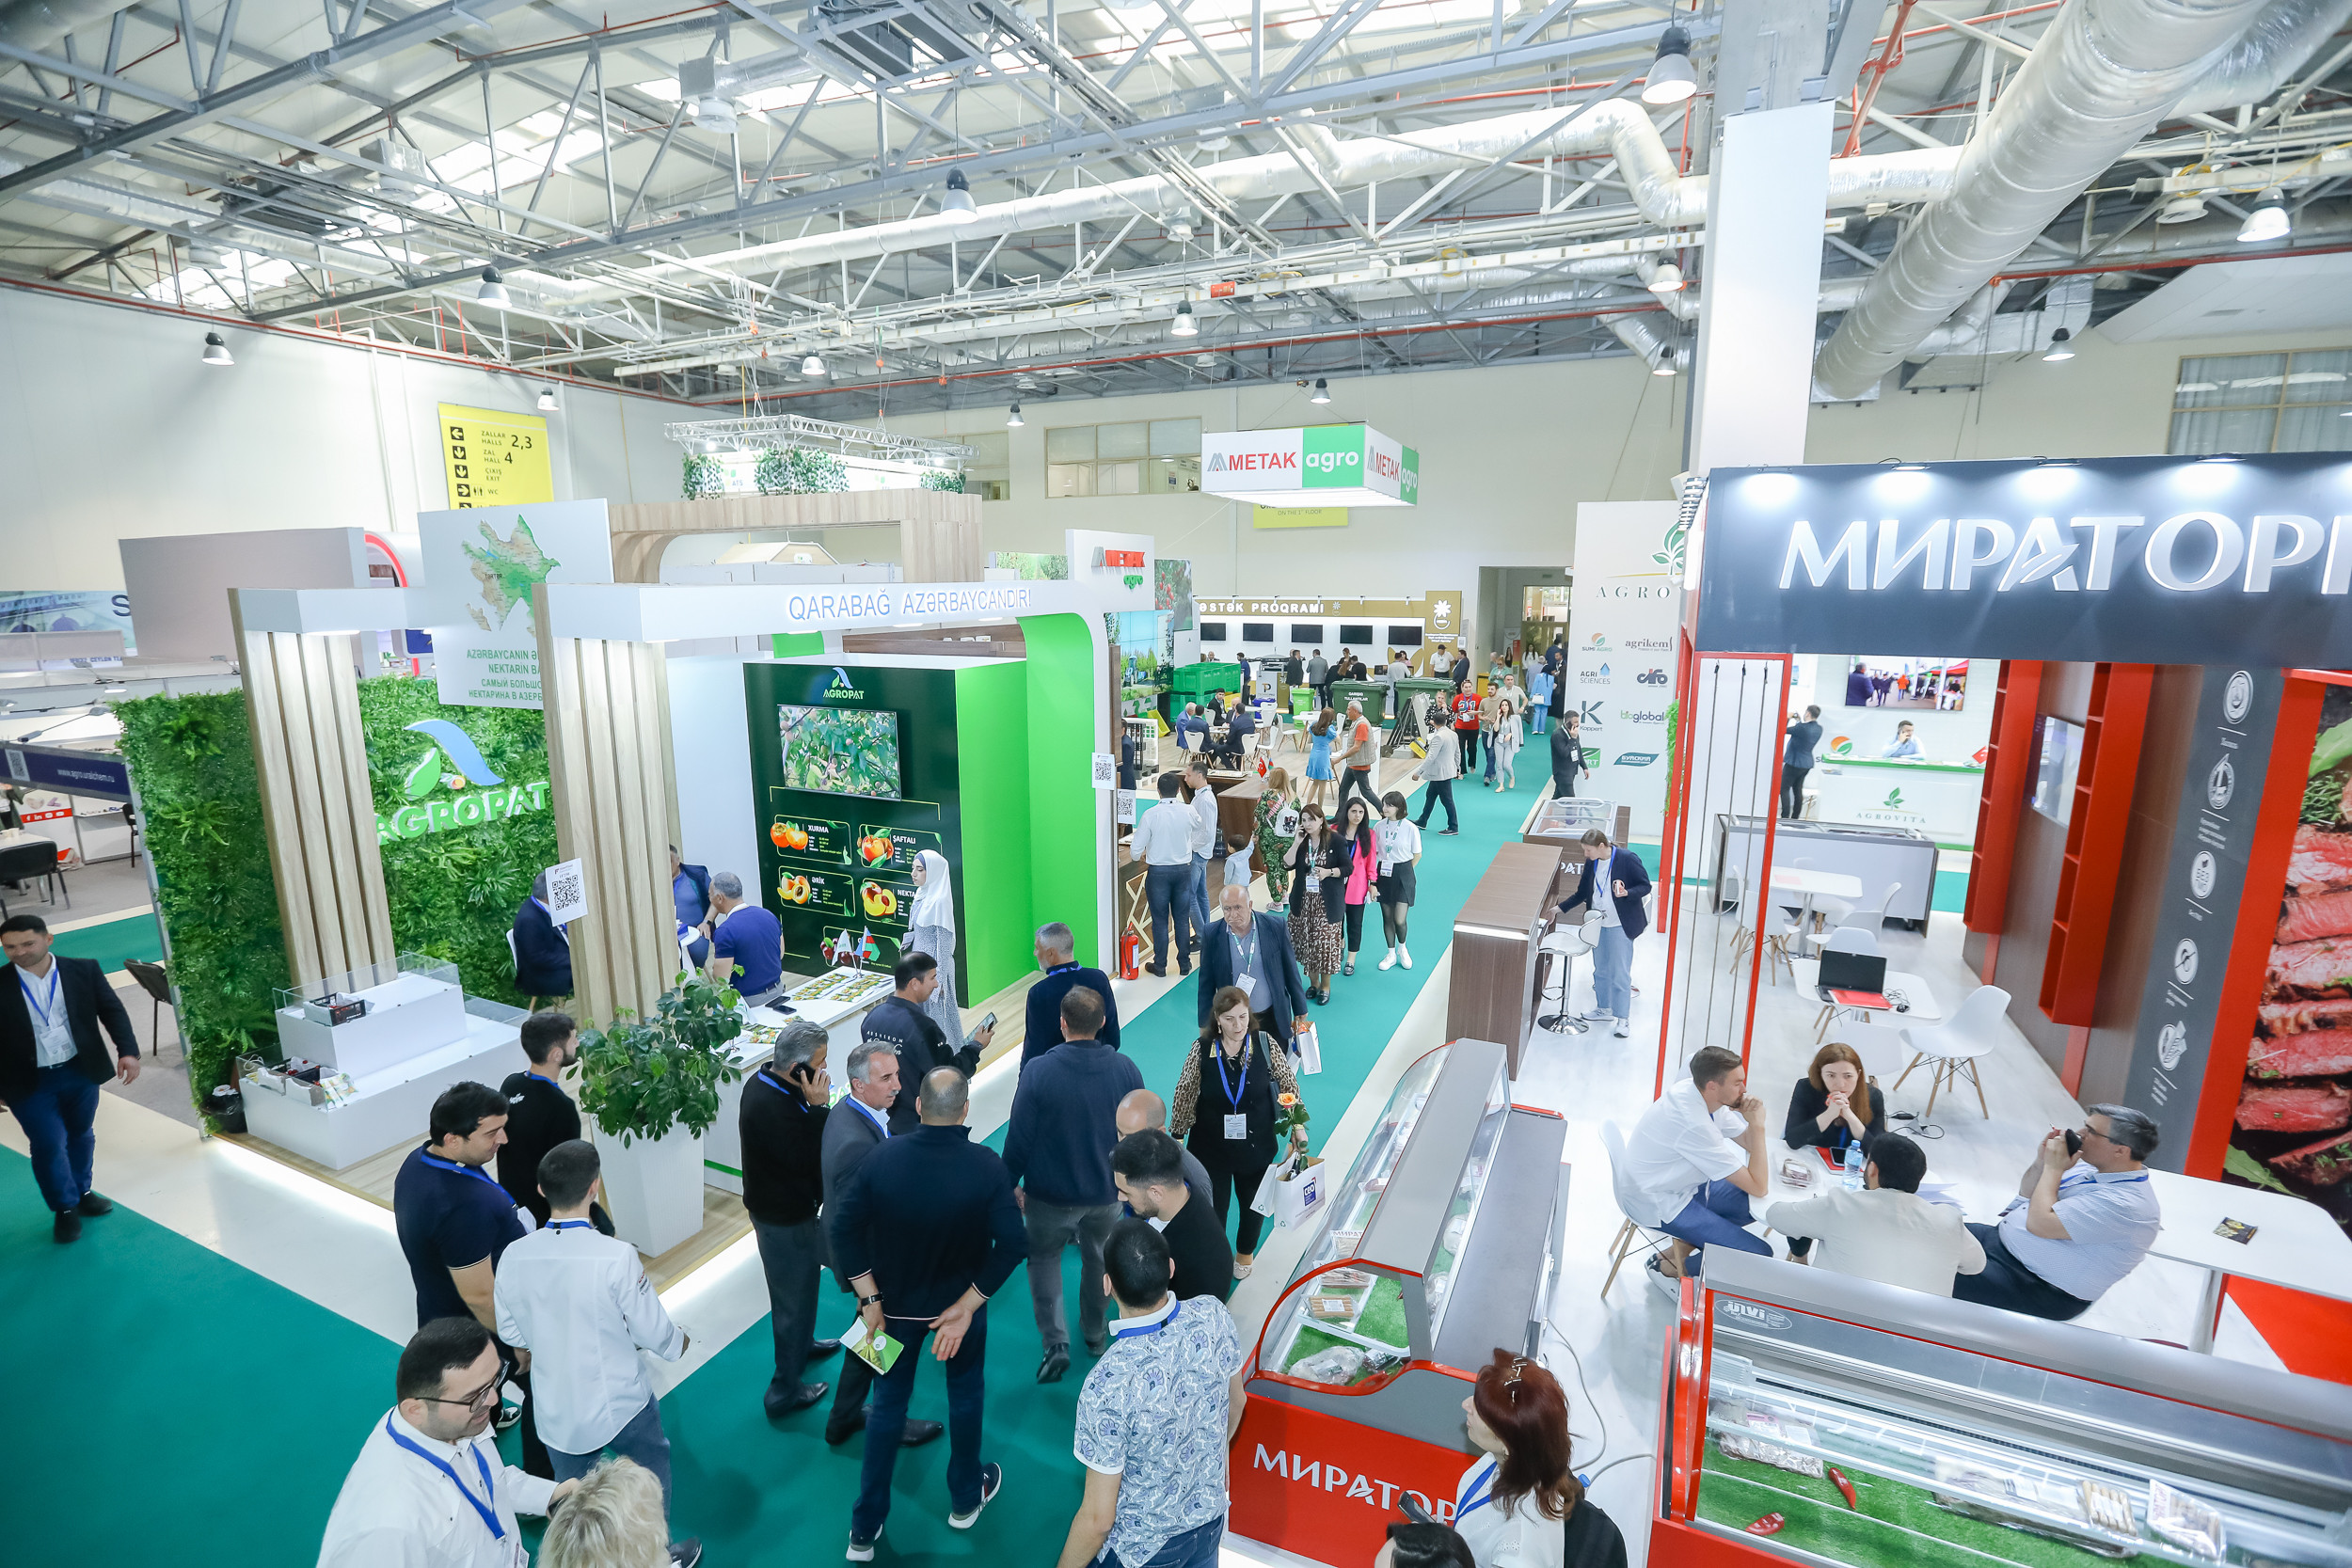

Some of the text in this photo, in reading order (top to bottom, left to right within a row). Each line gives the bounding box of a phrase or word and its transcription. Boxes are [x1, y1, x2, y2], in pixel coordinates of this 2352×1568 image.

[481, 430, 506, 438] ZALLAR
[511, 434, 532, 450] 2,3
[504, 451, 514, 464] 4
[1229, 451, 1359, 473] METAK agro
[1375, 451, 1418, 493] METAK agro
[1596, 586, 1681, 599] AGRO
[788, 588, 1032, 621] QARABAĞ AZƏRBAYCANDIR!
[1625, 638, 1669, 649] agrikem
[466, 649, 529, 660] AZƏRBAYCANIN
[822, 689, 865, 700] AGROPAT
[374, 781, 550, 846] AGROPAT
[1855, 811, 1927, 824] AGROVITA
[1304, 1183, 1315, 1196] CEO
